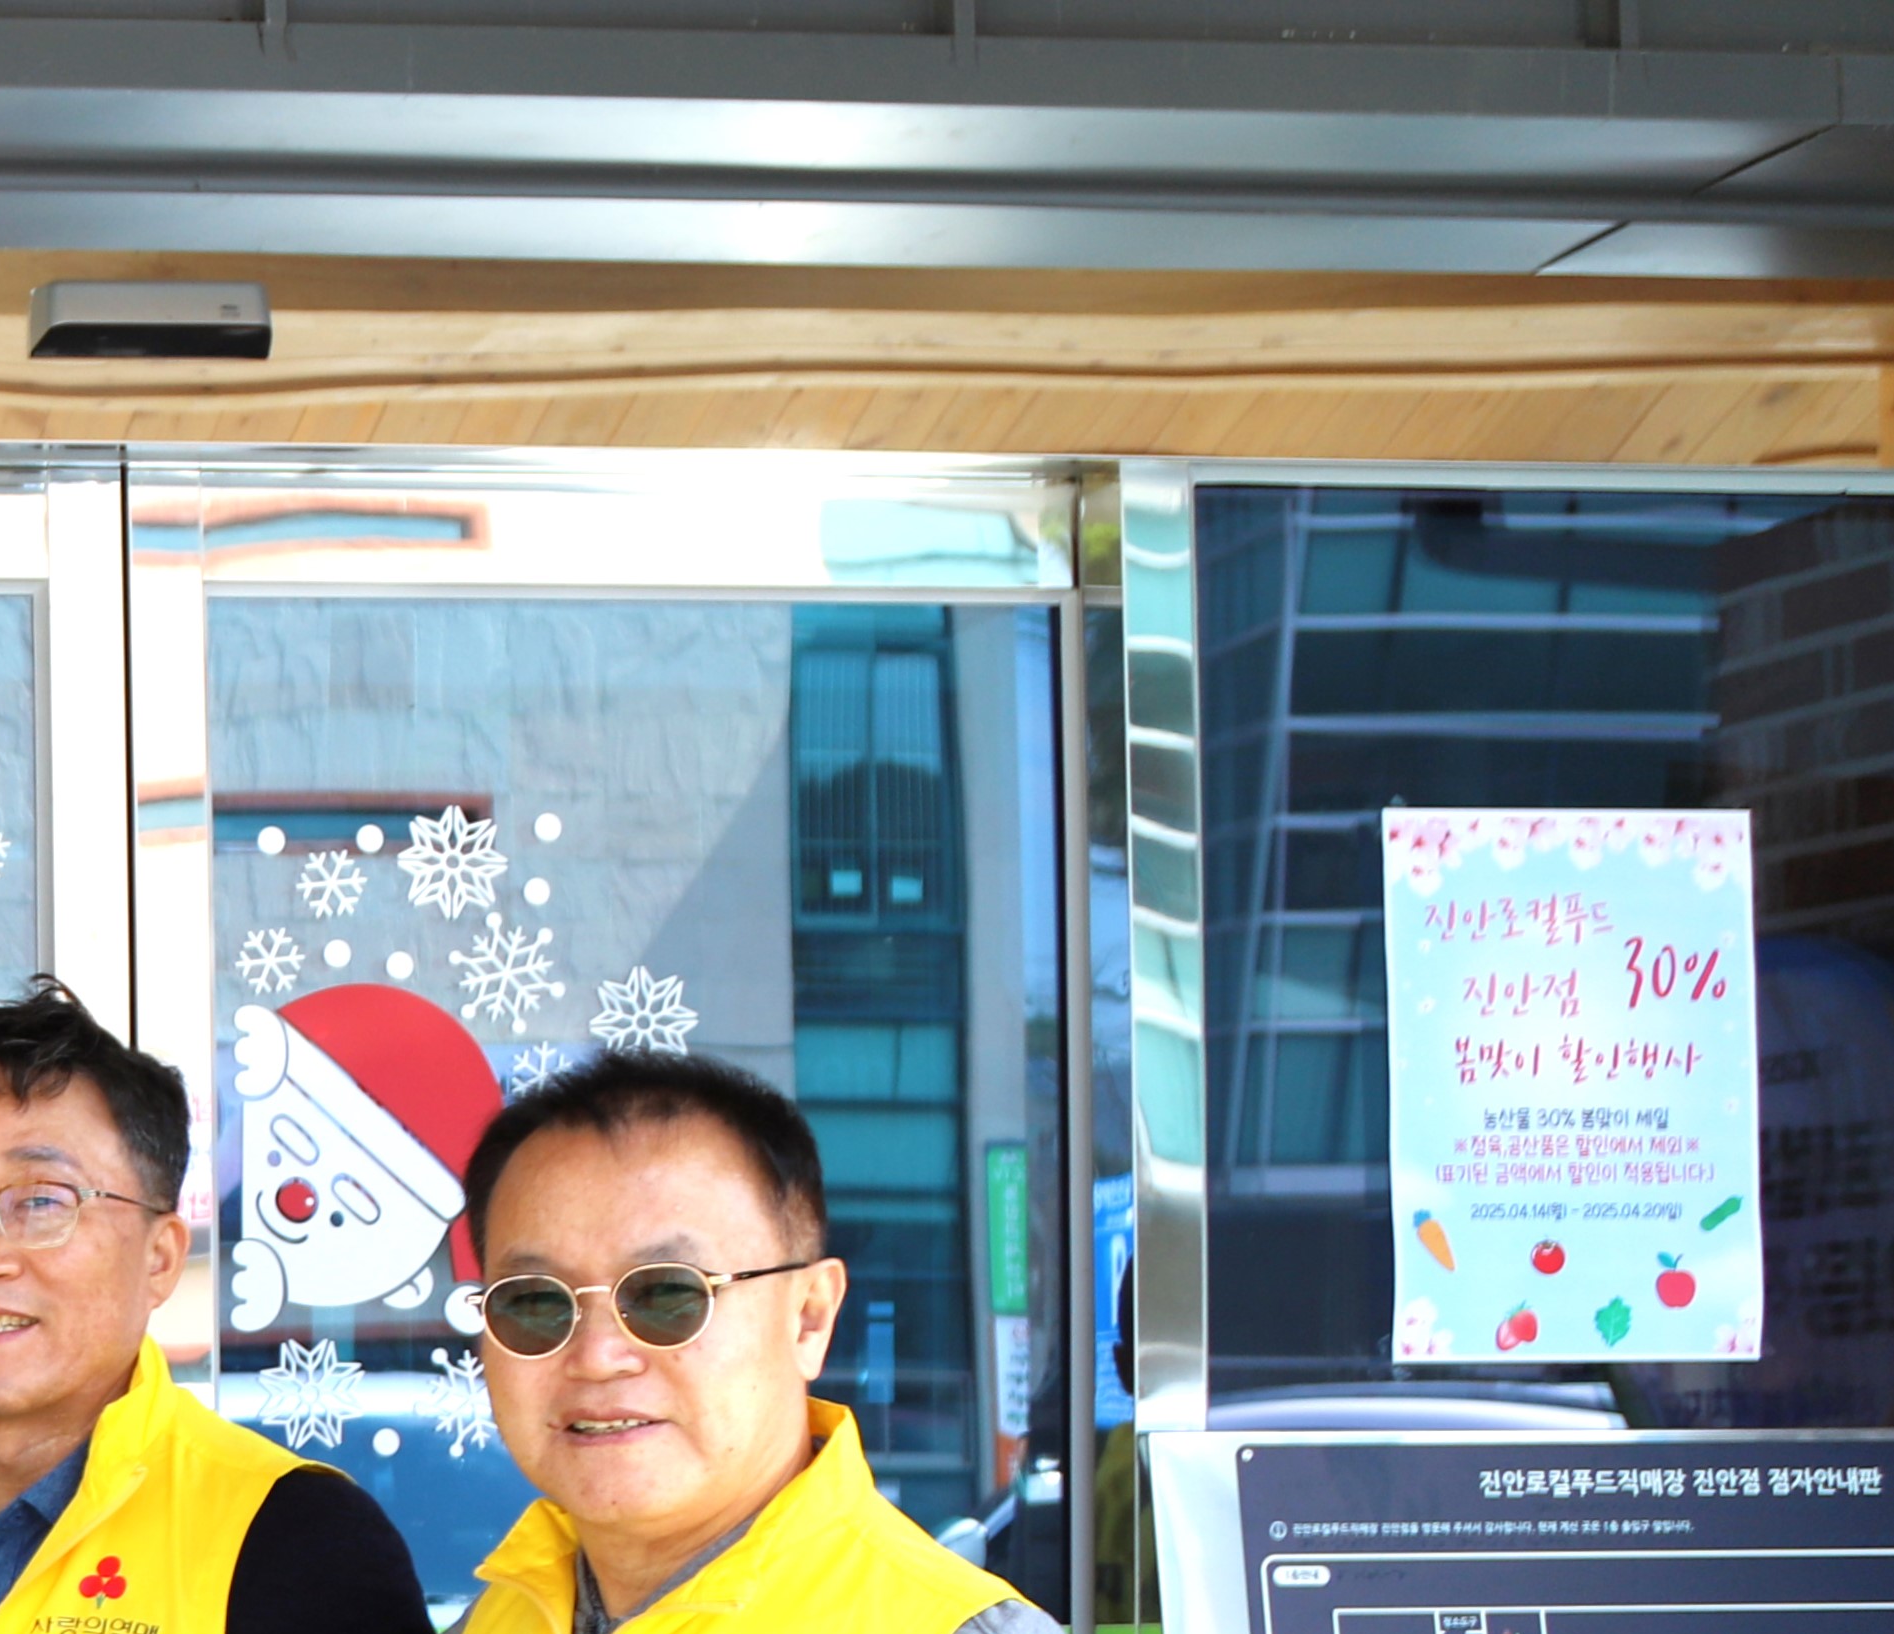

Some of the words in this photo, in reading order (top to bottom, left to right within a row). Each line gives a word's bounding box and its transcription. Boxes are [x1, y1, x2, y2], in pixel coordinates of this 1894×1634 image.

[1424, 892, 1615, 946] 진안로컬푸드
[1463, 967, 1580, 1017] 진안점
[1624, 935, 1727, 1010] 30%
[1455, 1035, 1541, 1085] 봄맞이
[1558, 1033, 1703, 1085] 할인행사
[1483, 1106, 1531, 1130] 농산물
[1536, 1108, 1576, 1128] 30%
[1581, 1107, 1629, 1130] 봄맞이
[1635, 1107, 1669, 1130] 세일
[1575, 1134, 1643, 1157] 할인에서
[1495, 1163, 1562, 1185] 금액에서
[1568, 1162, 1618, 1185] 할인이
[1479, 1468, 1686, 1499] 진안로컬푸드직매장
[1693, 1467, 1761, 1498] 진안점
[1768, 1466, 1884, 1498] 점자안내판
